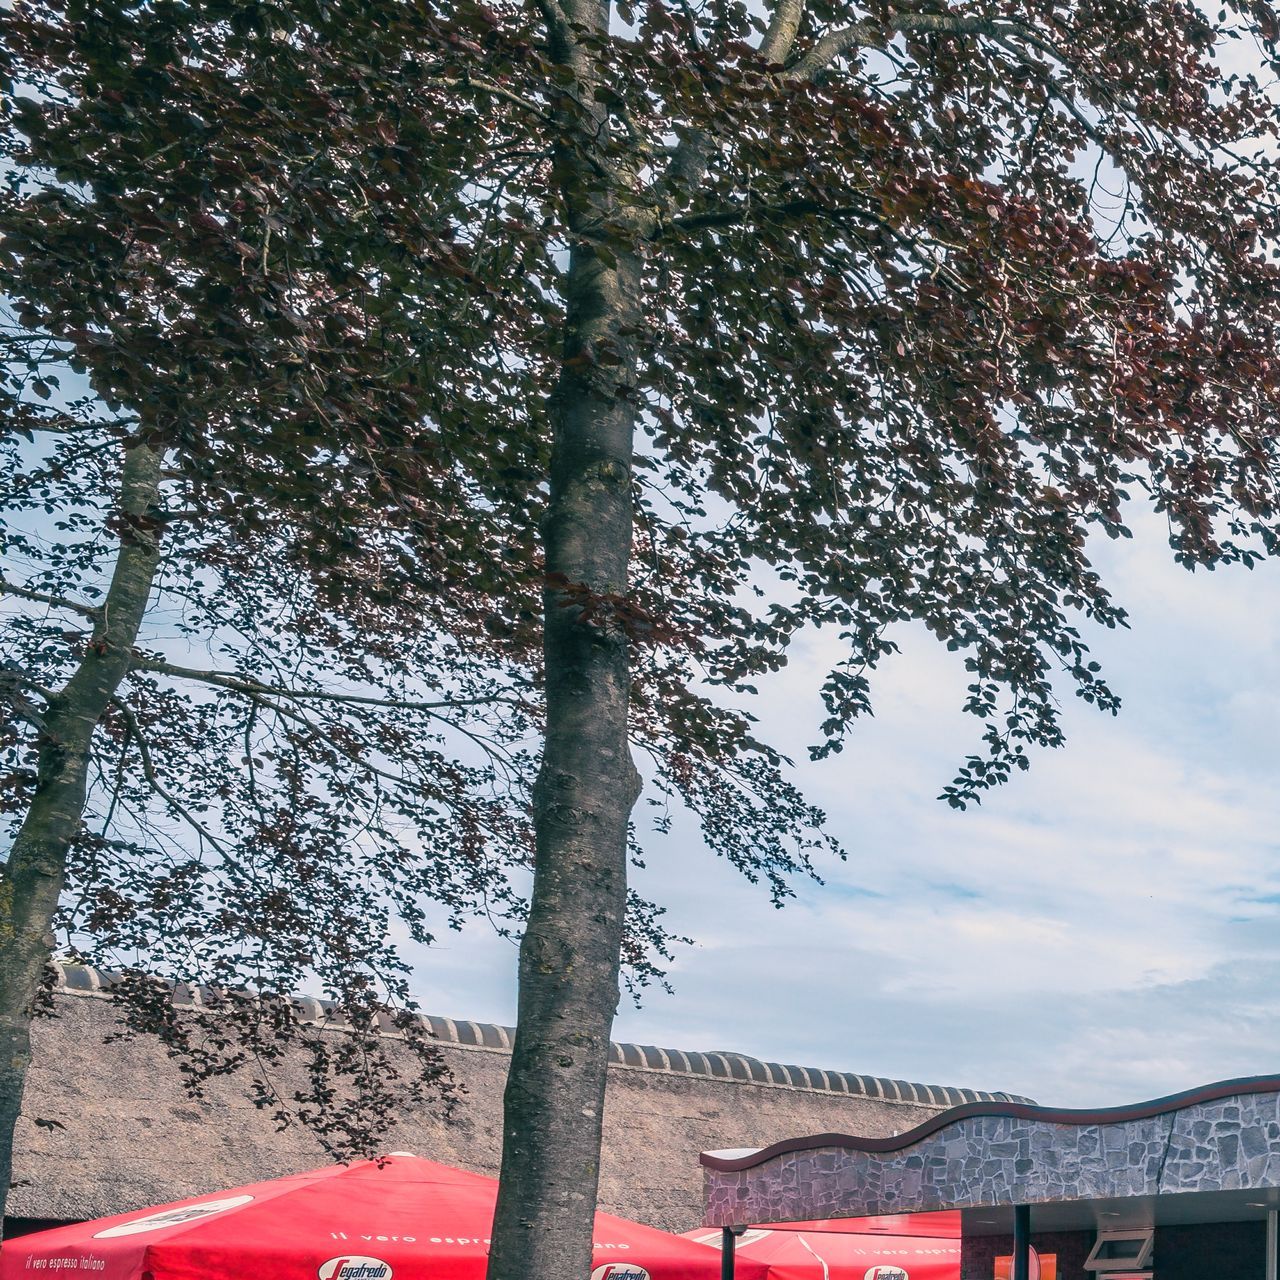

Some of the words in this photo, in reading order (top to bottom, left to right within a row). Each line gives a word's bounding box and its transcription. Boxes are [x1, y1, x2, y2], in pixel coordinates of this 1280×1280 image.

[331, 1232, 348, 1240] il
[360, 1234, 416, 1242] vero
[430, 1237, 491, 1245] espre
[26, 1254, 33, 1269] il
[33, 1259, 47, 1269] vero
[49, 1257, 78, 1272] espresso
[79, 1253, 105, 1271] italiano
